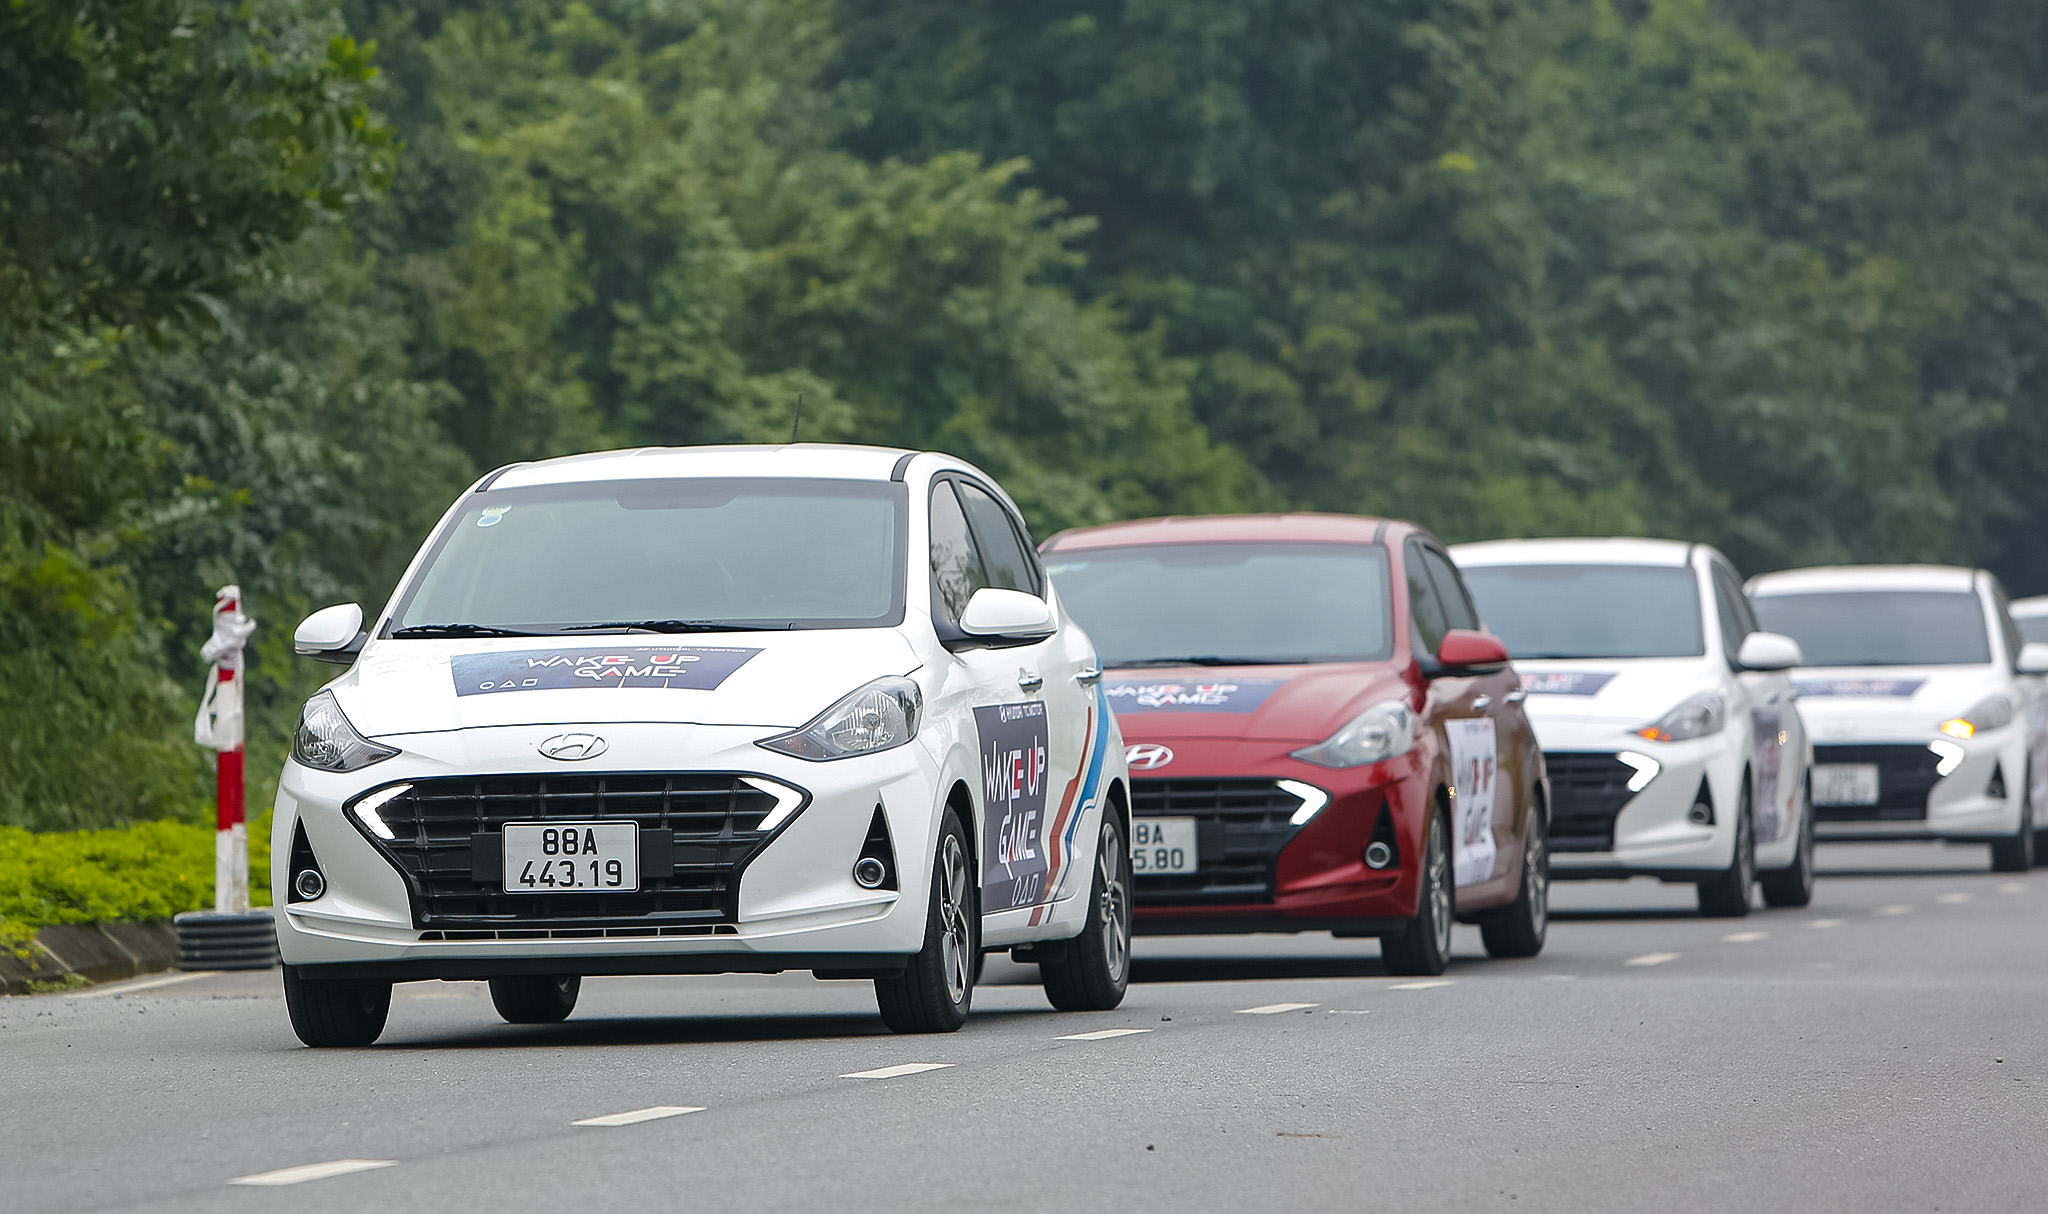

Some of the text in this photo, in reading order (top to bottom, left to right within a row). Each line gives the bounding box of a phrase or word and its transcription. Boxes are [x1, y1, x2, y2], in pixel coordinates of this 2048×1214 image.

[527, 653, 701, 669] WAKE UP
[573, 665, 687, 681] GAME
[984, 734, 1046, 804] WAKE UP
[542, 828, 599, 855] 88A
[998, 809, 1038, 865] GAME
[1132, 824, 1164, 844] 8A
[520, 859, 622, 887] 443.19
